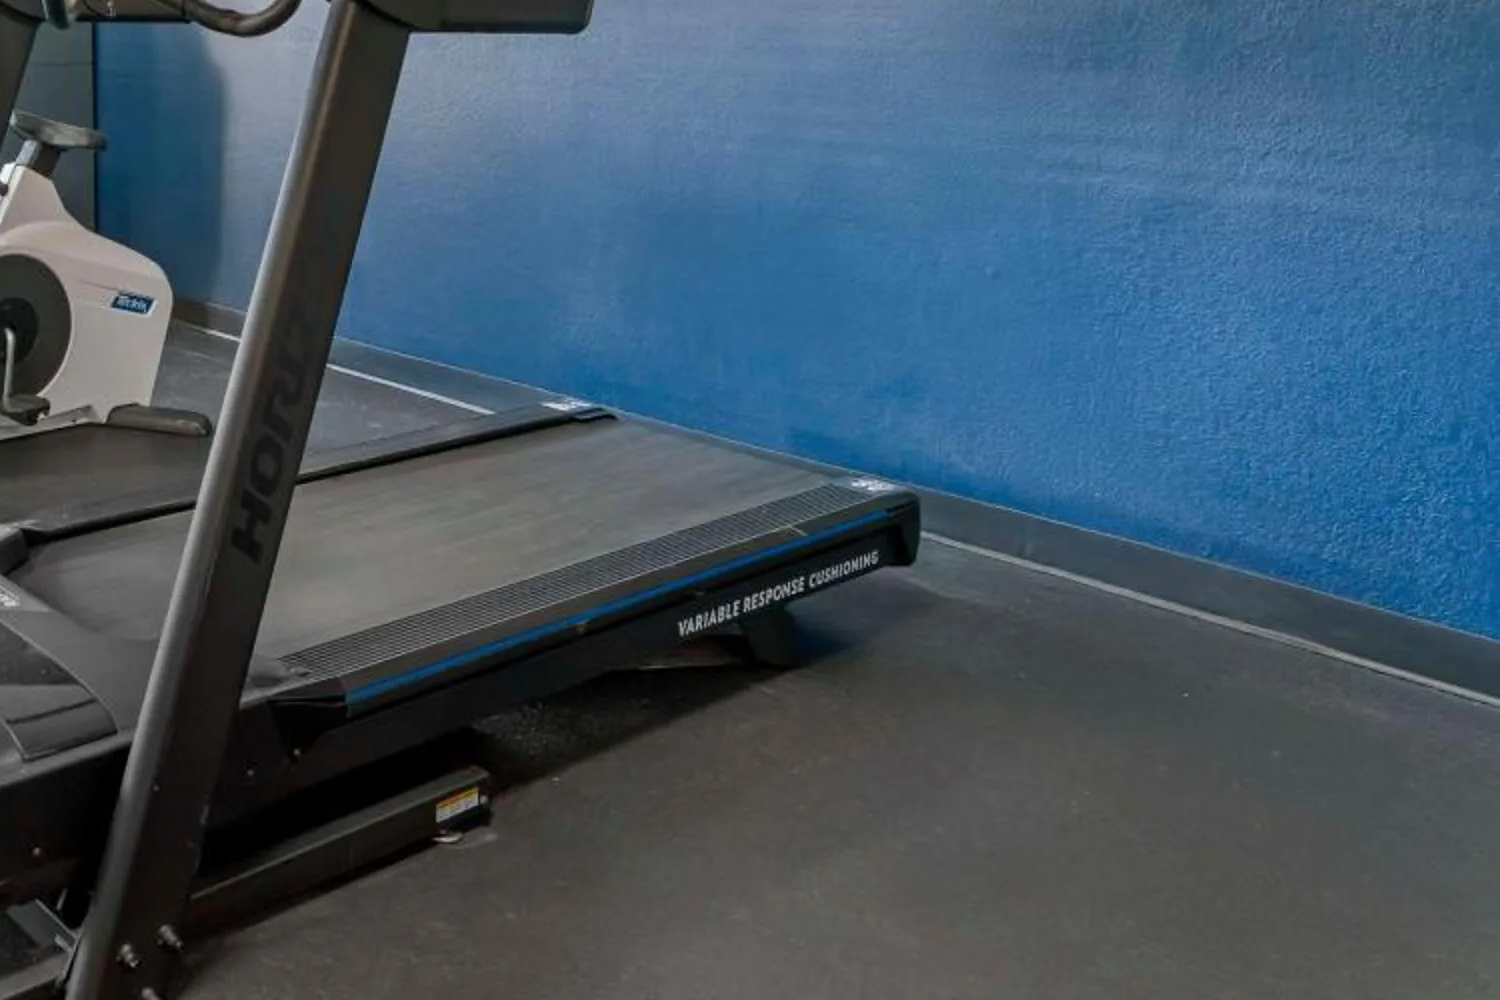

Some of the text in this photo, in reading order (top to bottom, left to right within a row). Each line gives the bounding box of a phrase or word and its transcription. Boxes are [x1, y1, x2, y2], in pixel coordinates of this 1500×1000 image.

[677, 550, 880, 637] VARIABLE RESPONSE CUSHIONING
